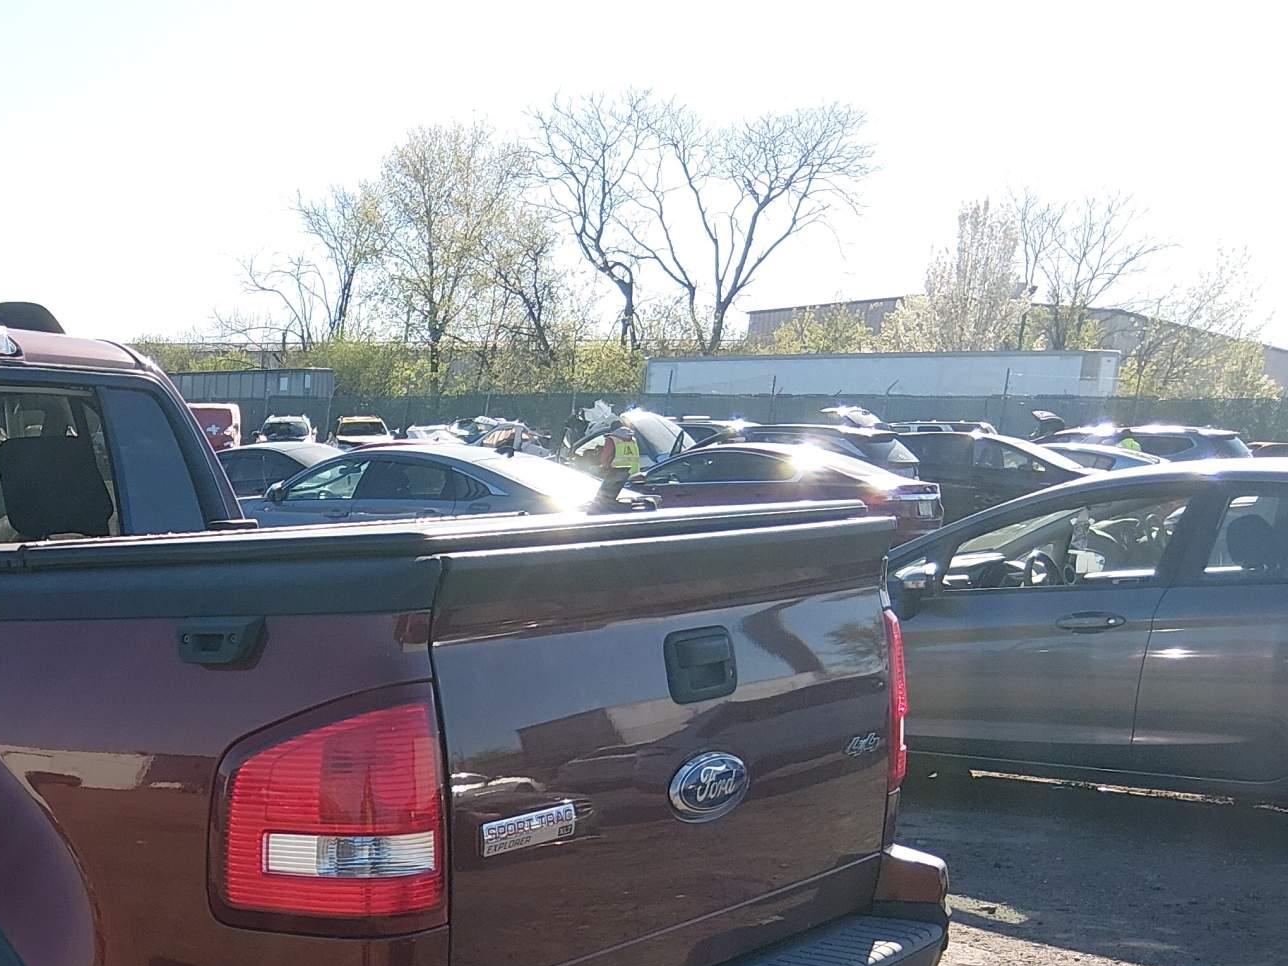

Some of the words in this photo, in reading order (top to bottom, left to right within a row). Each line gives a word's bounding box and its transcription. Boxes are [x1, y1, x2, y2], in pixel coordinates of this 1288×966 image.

[689, 764, 737, 802] Ford
[486, 818, 532, 841] SPORT
[535, 808, 573, 828] TRAC
[486, 836, 532, 854] EXPLORER
